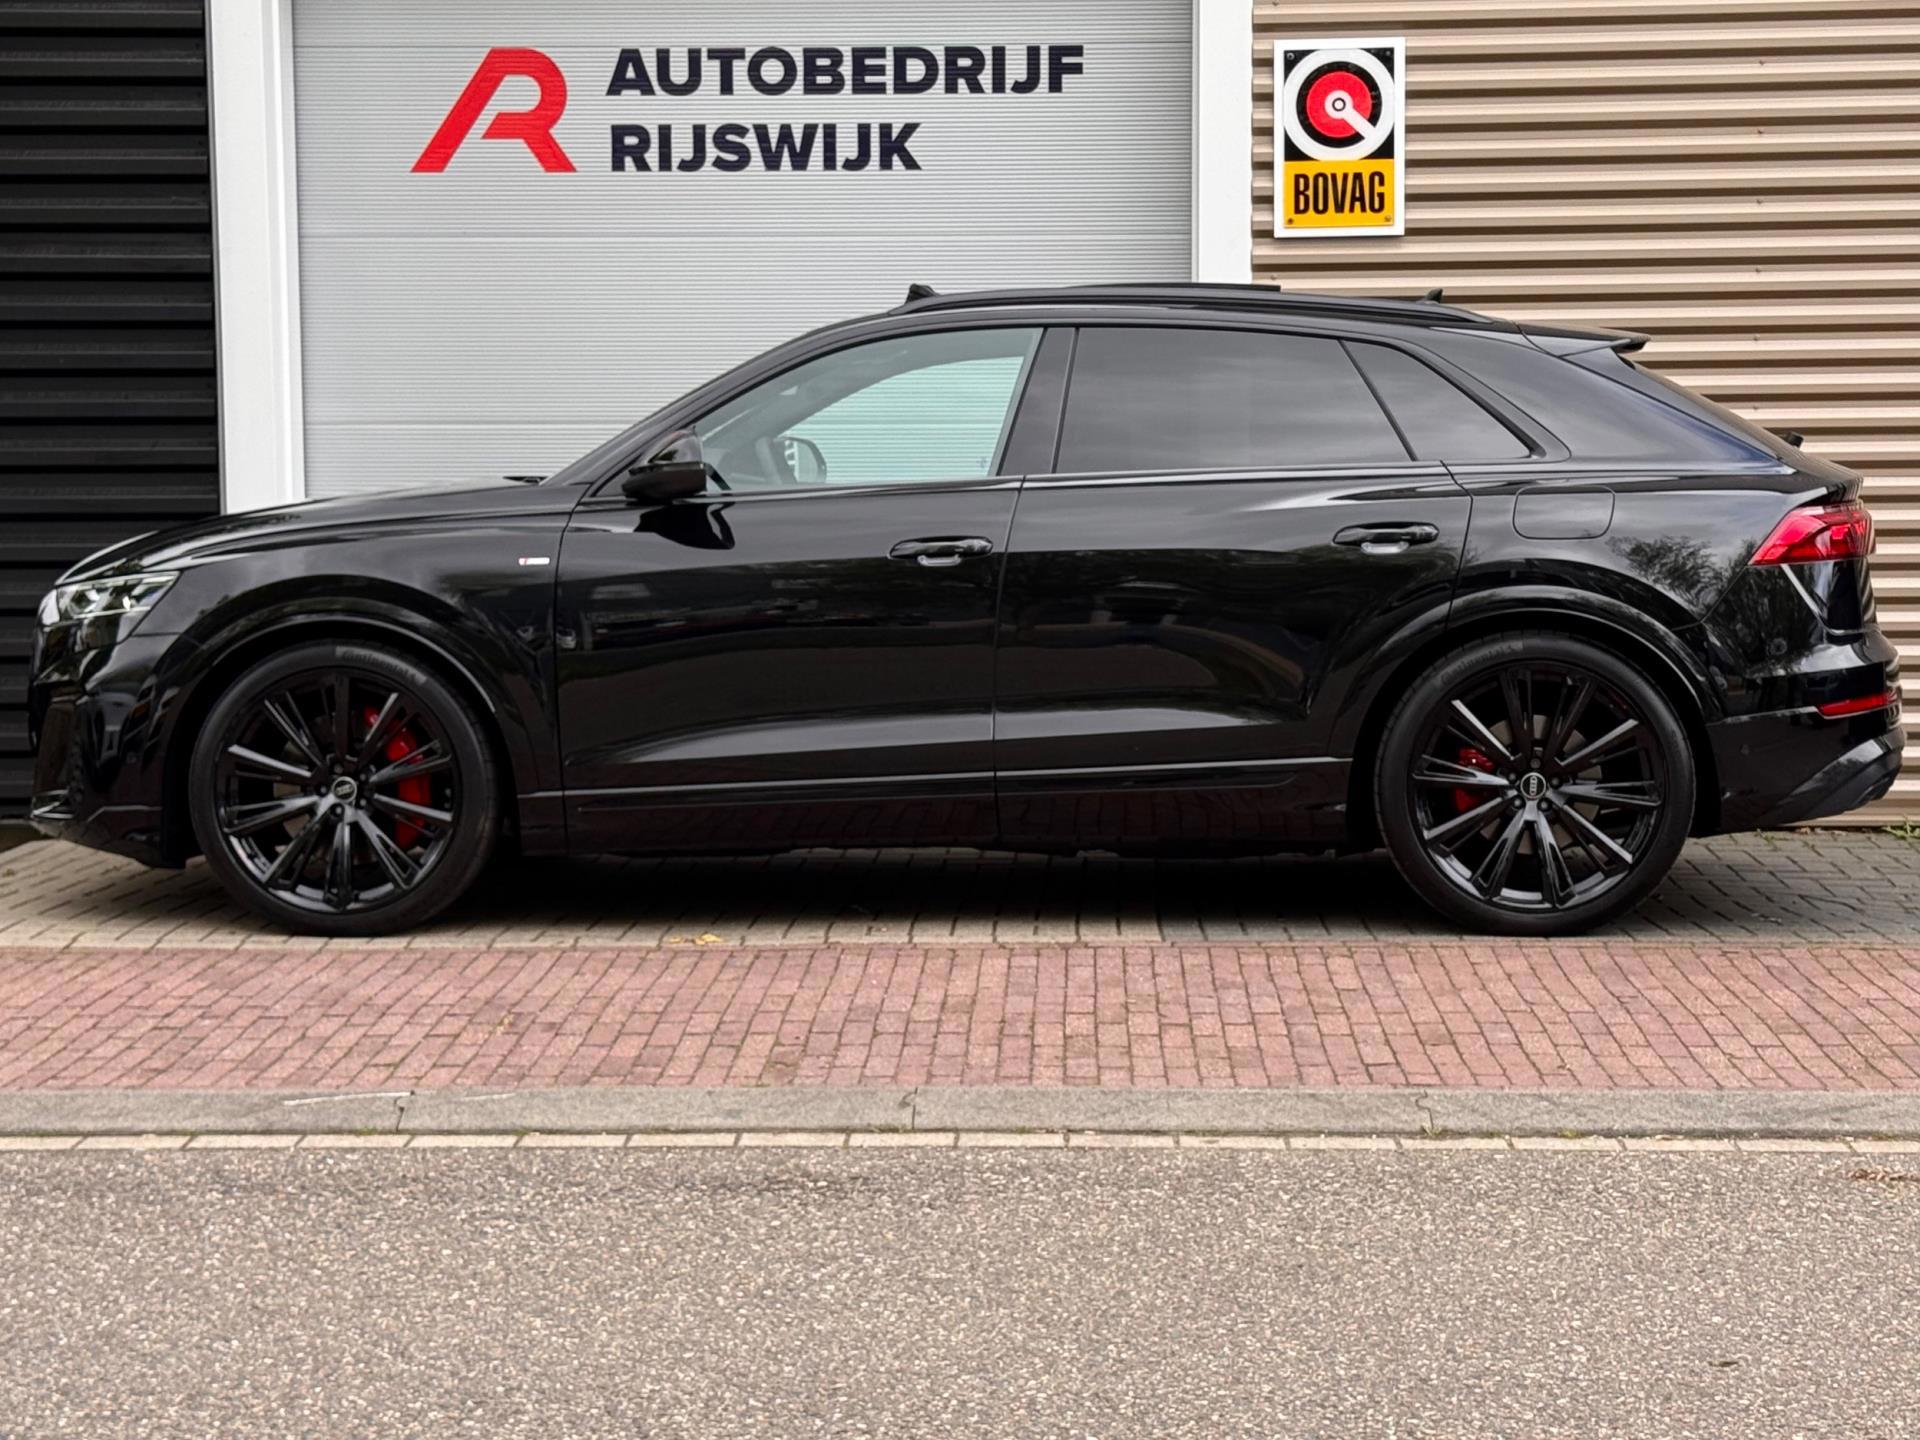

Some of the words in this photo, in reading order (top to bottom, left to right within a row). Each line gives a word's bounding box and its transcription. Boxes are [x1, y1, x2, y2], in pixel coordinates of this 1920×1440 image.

[606, 45, 1084, 96] AUTOBEDRIJF
[611, 123, 922, 172] RIJSWIJK
[1294, 171, 1385, 215] BOVAG
